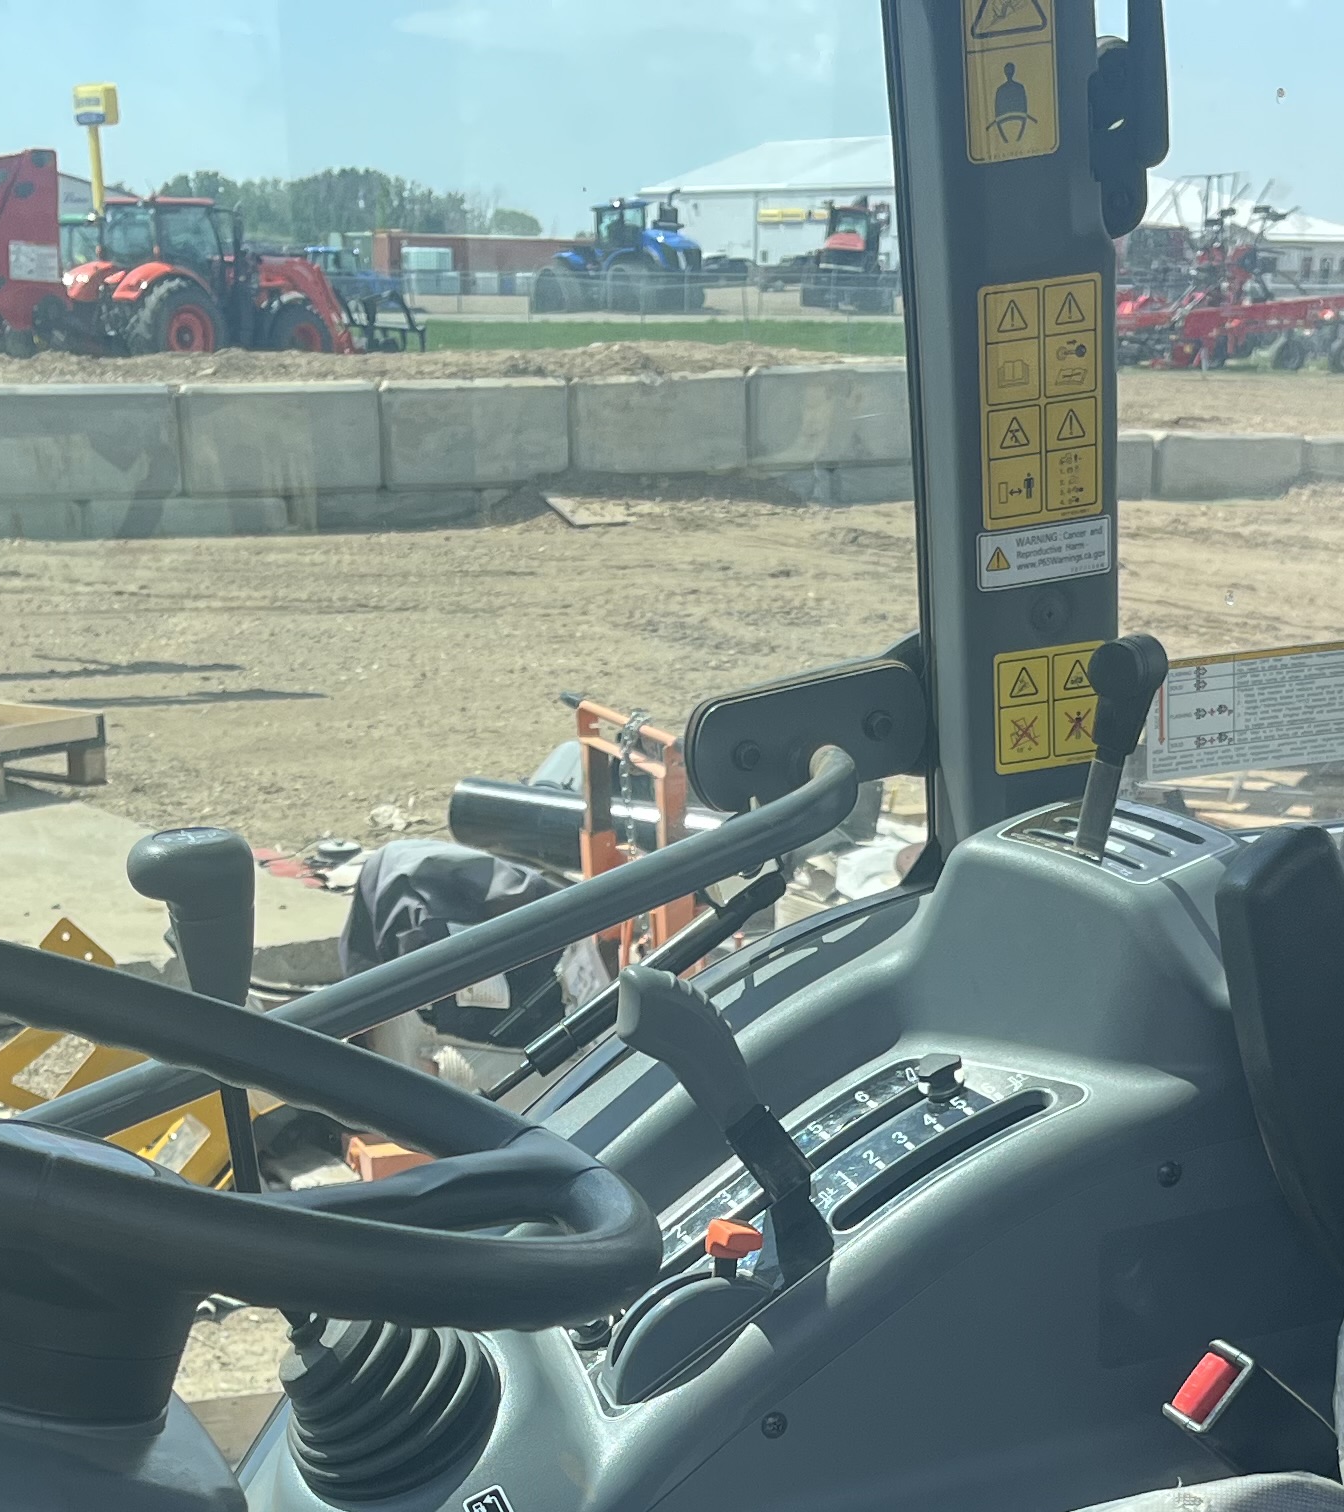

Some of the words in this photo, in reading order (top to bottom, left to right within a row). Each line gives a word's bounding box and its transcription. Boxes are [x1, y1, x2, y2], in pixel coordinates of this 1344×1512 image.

[1063, 530, 1087, 540] Cancer
[1090, 525, 1103, 535] and
[1016, 545, 1062, 559] Reproductive
[1065, 542, 1085, 552] Harm
[806, 1121, 824, 1135] 5
[854, 1090, 870, 1103] 6
[836, 1169, 855, 1184] 1
[862, 1149, 881, 1165] 2
[891, 1131, 908, 1144] 3
[922, 1113, 938, 1126] 4
[950, 1096, 967, 1109] 5
[980, 1081, 996, 1094] 6
